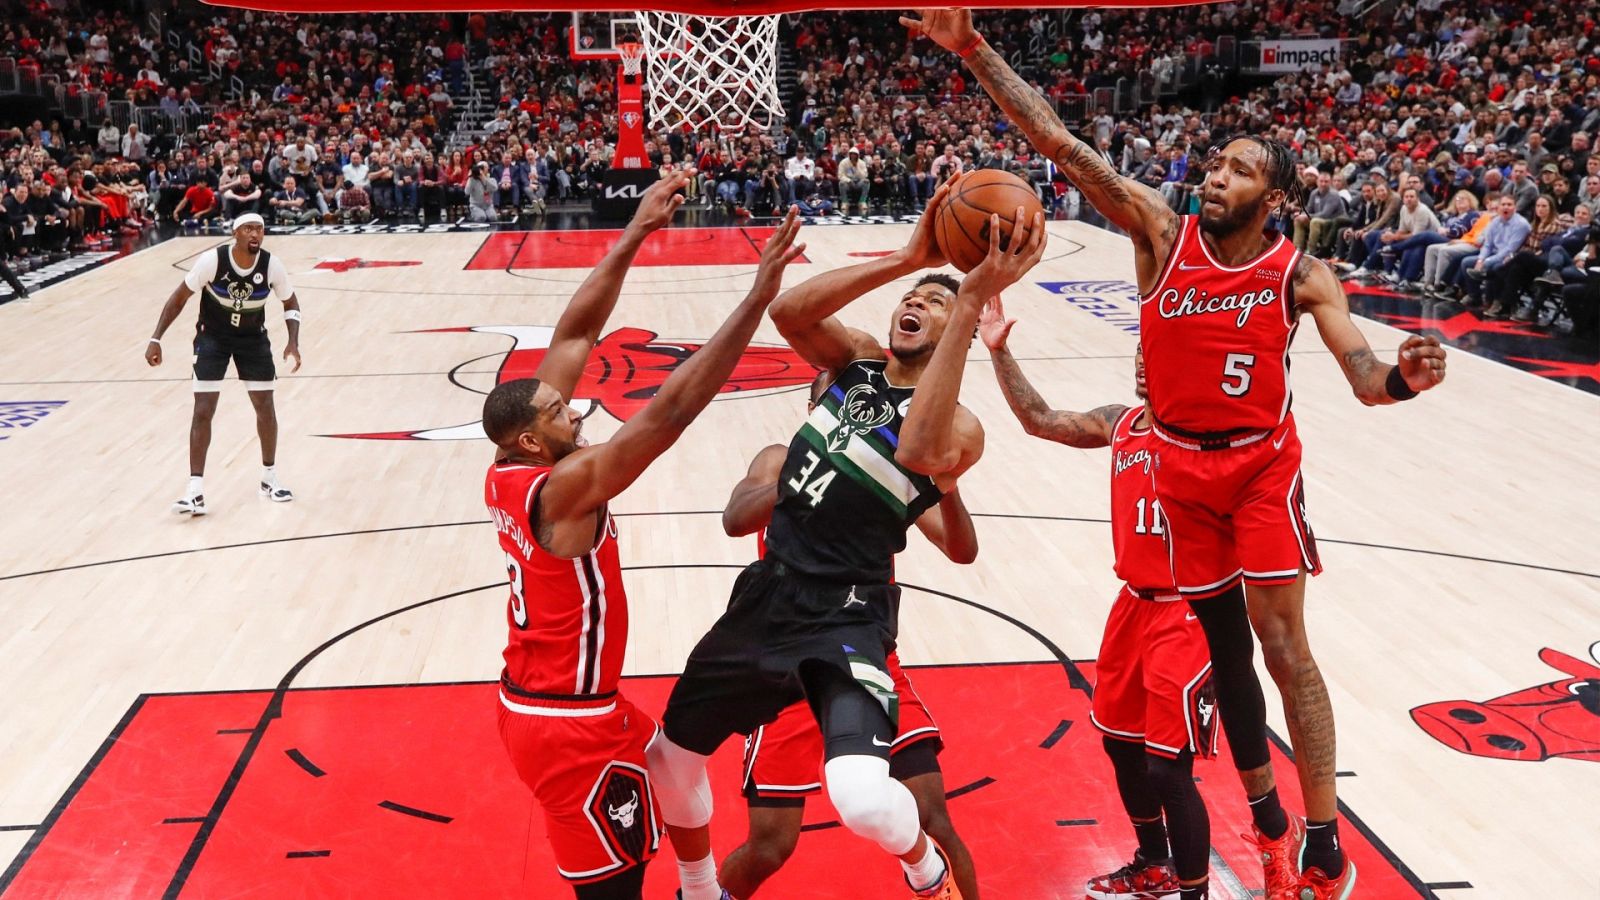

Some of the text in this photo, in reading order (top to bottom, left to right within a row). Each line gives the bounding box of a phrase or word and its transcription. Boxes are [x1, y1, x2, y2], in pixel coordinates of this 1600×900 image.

[1276, 45, 1336, 67] impact
[230, 312, 241, 327] 9
[1159, 287, 1277, 328] Chicago
[1220, 352, 1255, 396] 5
[788, 449, 837, 507] 34
[1113, 448, 1152, 477] hicag
[1135, 497, 1164, 535] 11
